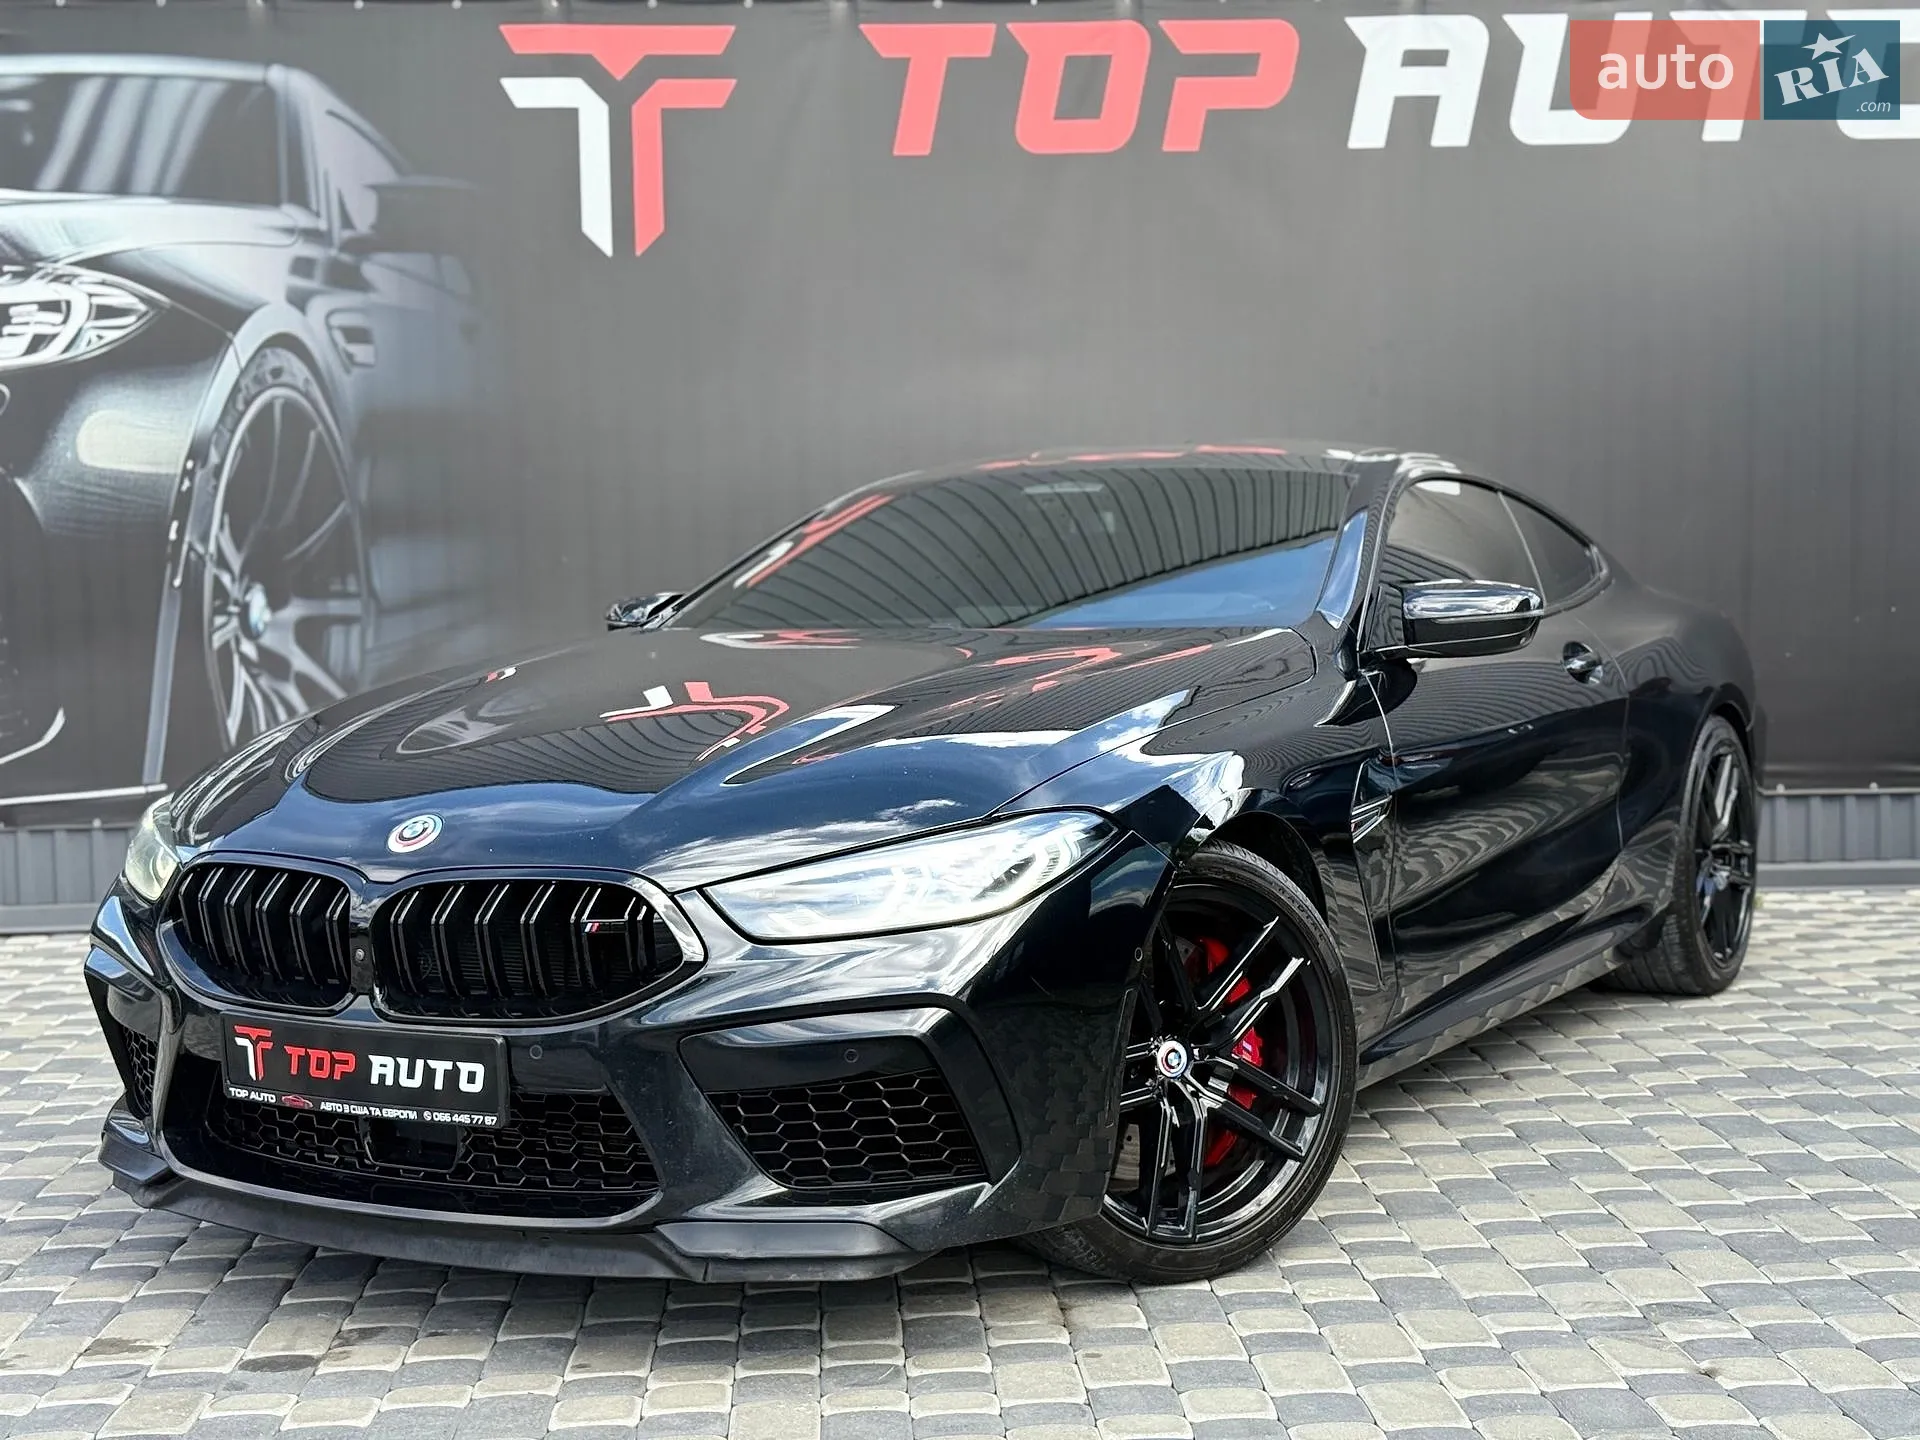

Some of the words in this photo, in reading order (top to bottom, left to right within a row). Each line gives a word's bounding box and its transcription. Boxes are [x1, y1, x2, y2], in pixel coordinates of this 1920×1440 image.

[858, 18, 1300, 156] TOP
[283, 1045, 356, 1080] TOP
[368, 1054, 485, 1093] AUTO
[229, 1087, 249, 1098] TOP
[249, 1091, 276, 1103] AUTO
[320, 1101, 342, 1112] АВТО
[350, 1105, 369, 1115] США
[369, 1106, 381, 1116] ТА
[433, 1111, 451, 1122] 066
[452, 1113, 471, 1124] 445
[471, 1114, 484, 1125] 77
